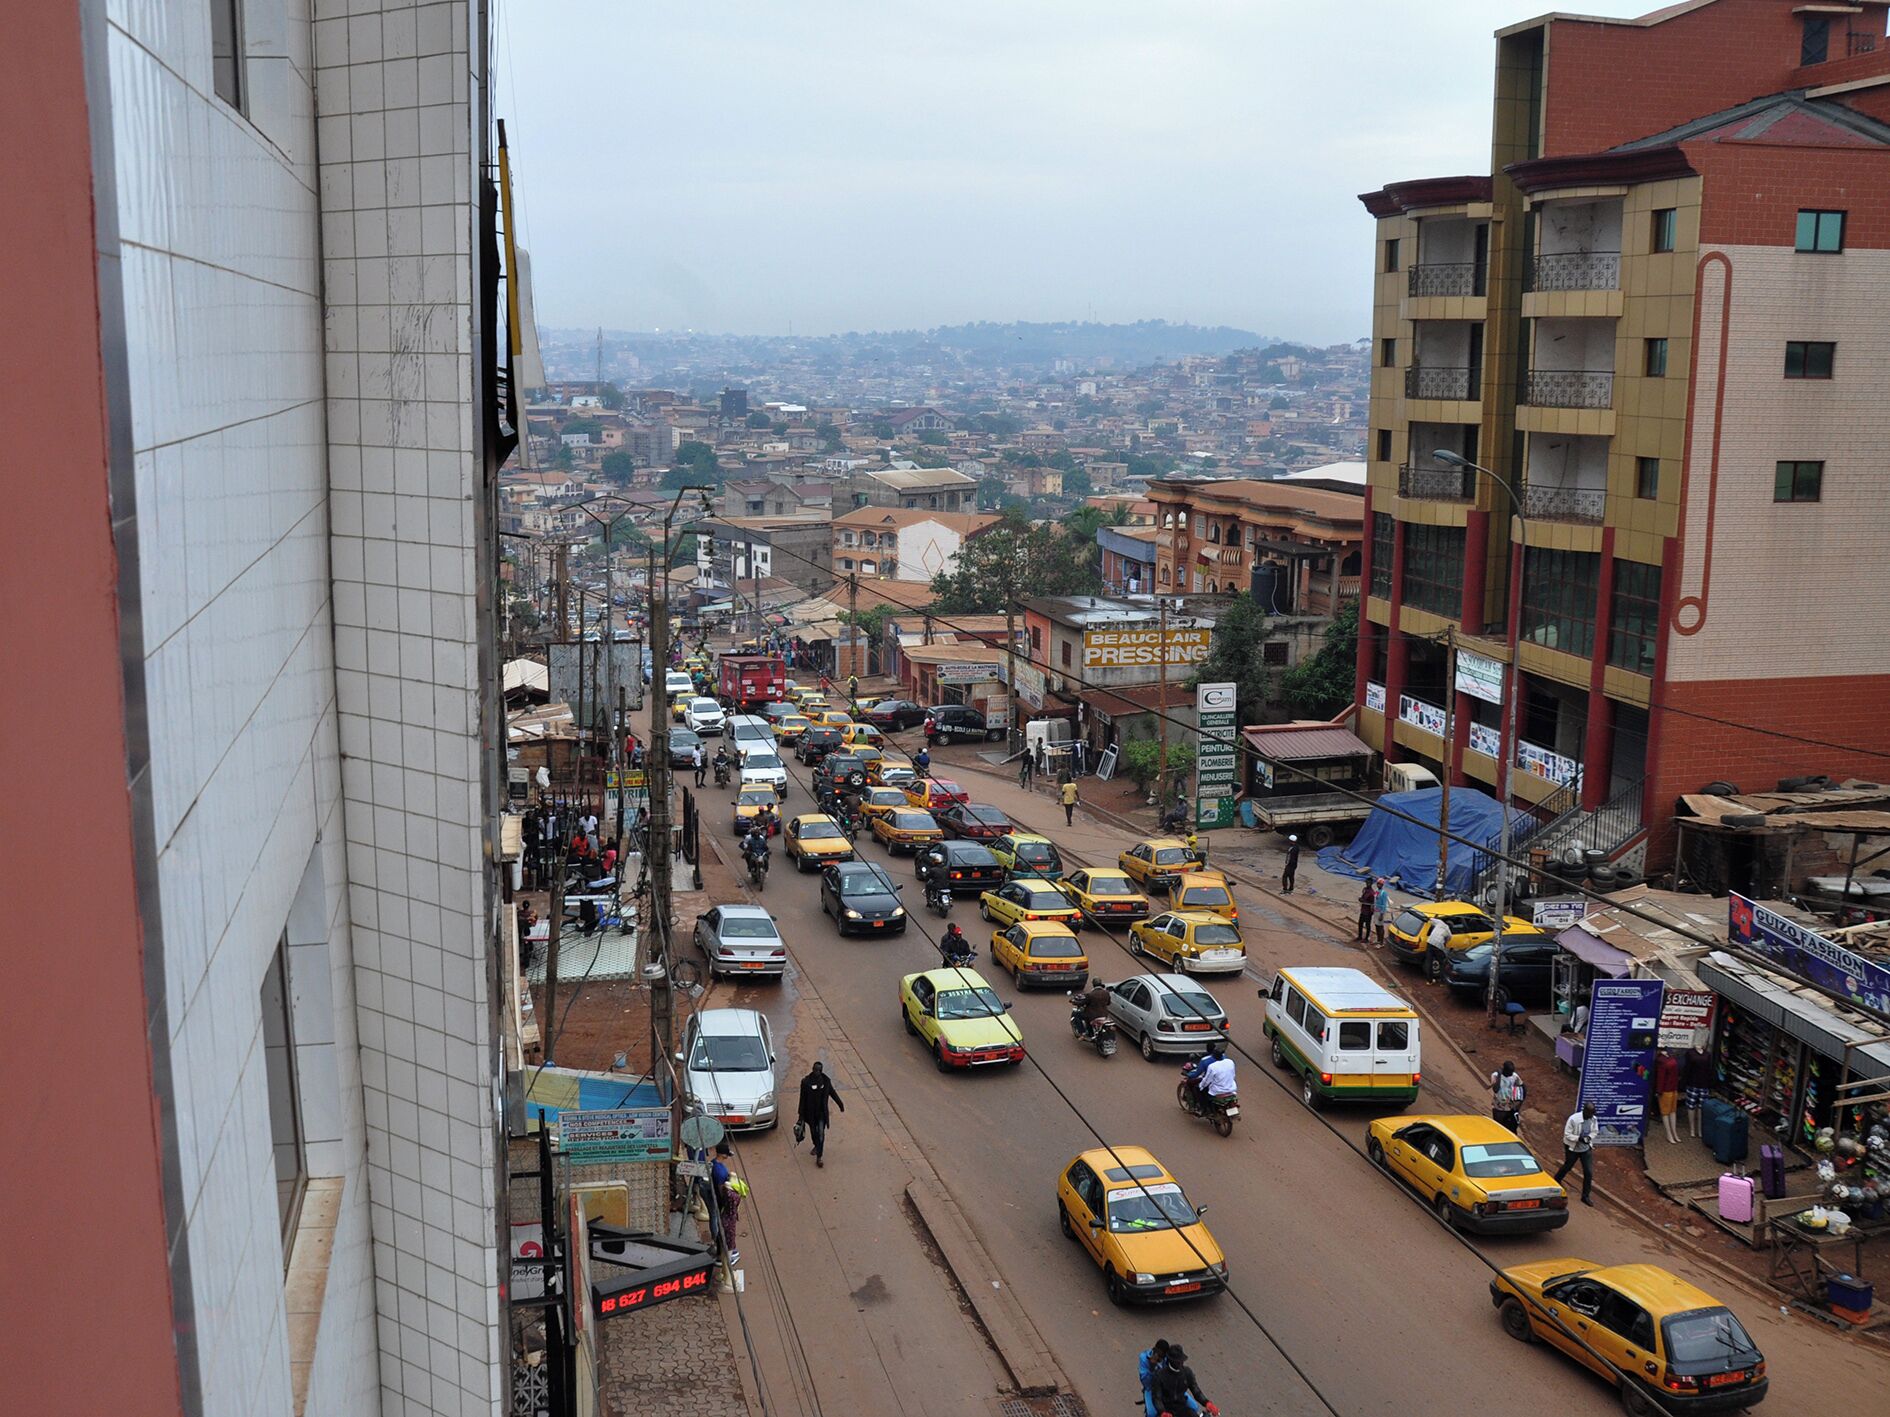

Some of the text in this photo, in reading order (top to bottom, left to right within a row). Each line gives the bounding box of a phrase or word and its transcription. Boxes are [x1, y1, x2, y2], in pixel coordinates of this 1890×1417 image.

[1091, 633, 1202, 645] BEAUCLAIR
[1085, 645, 1208, 664] PRESSING
[1201, 744, 1234, 753] PEINTURE
[1200, 757, 1234, 767] PLOMBERIE
[1755, 909, 1863, 973] GUIZO FASHION
[1672, 993, 1713, 1007] EXCHANGE
[618, 1289, 646, 1307] 627
[653, 1279, 681, 1298] 694
